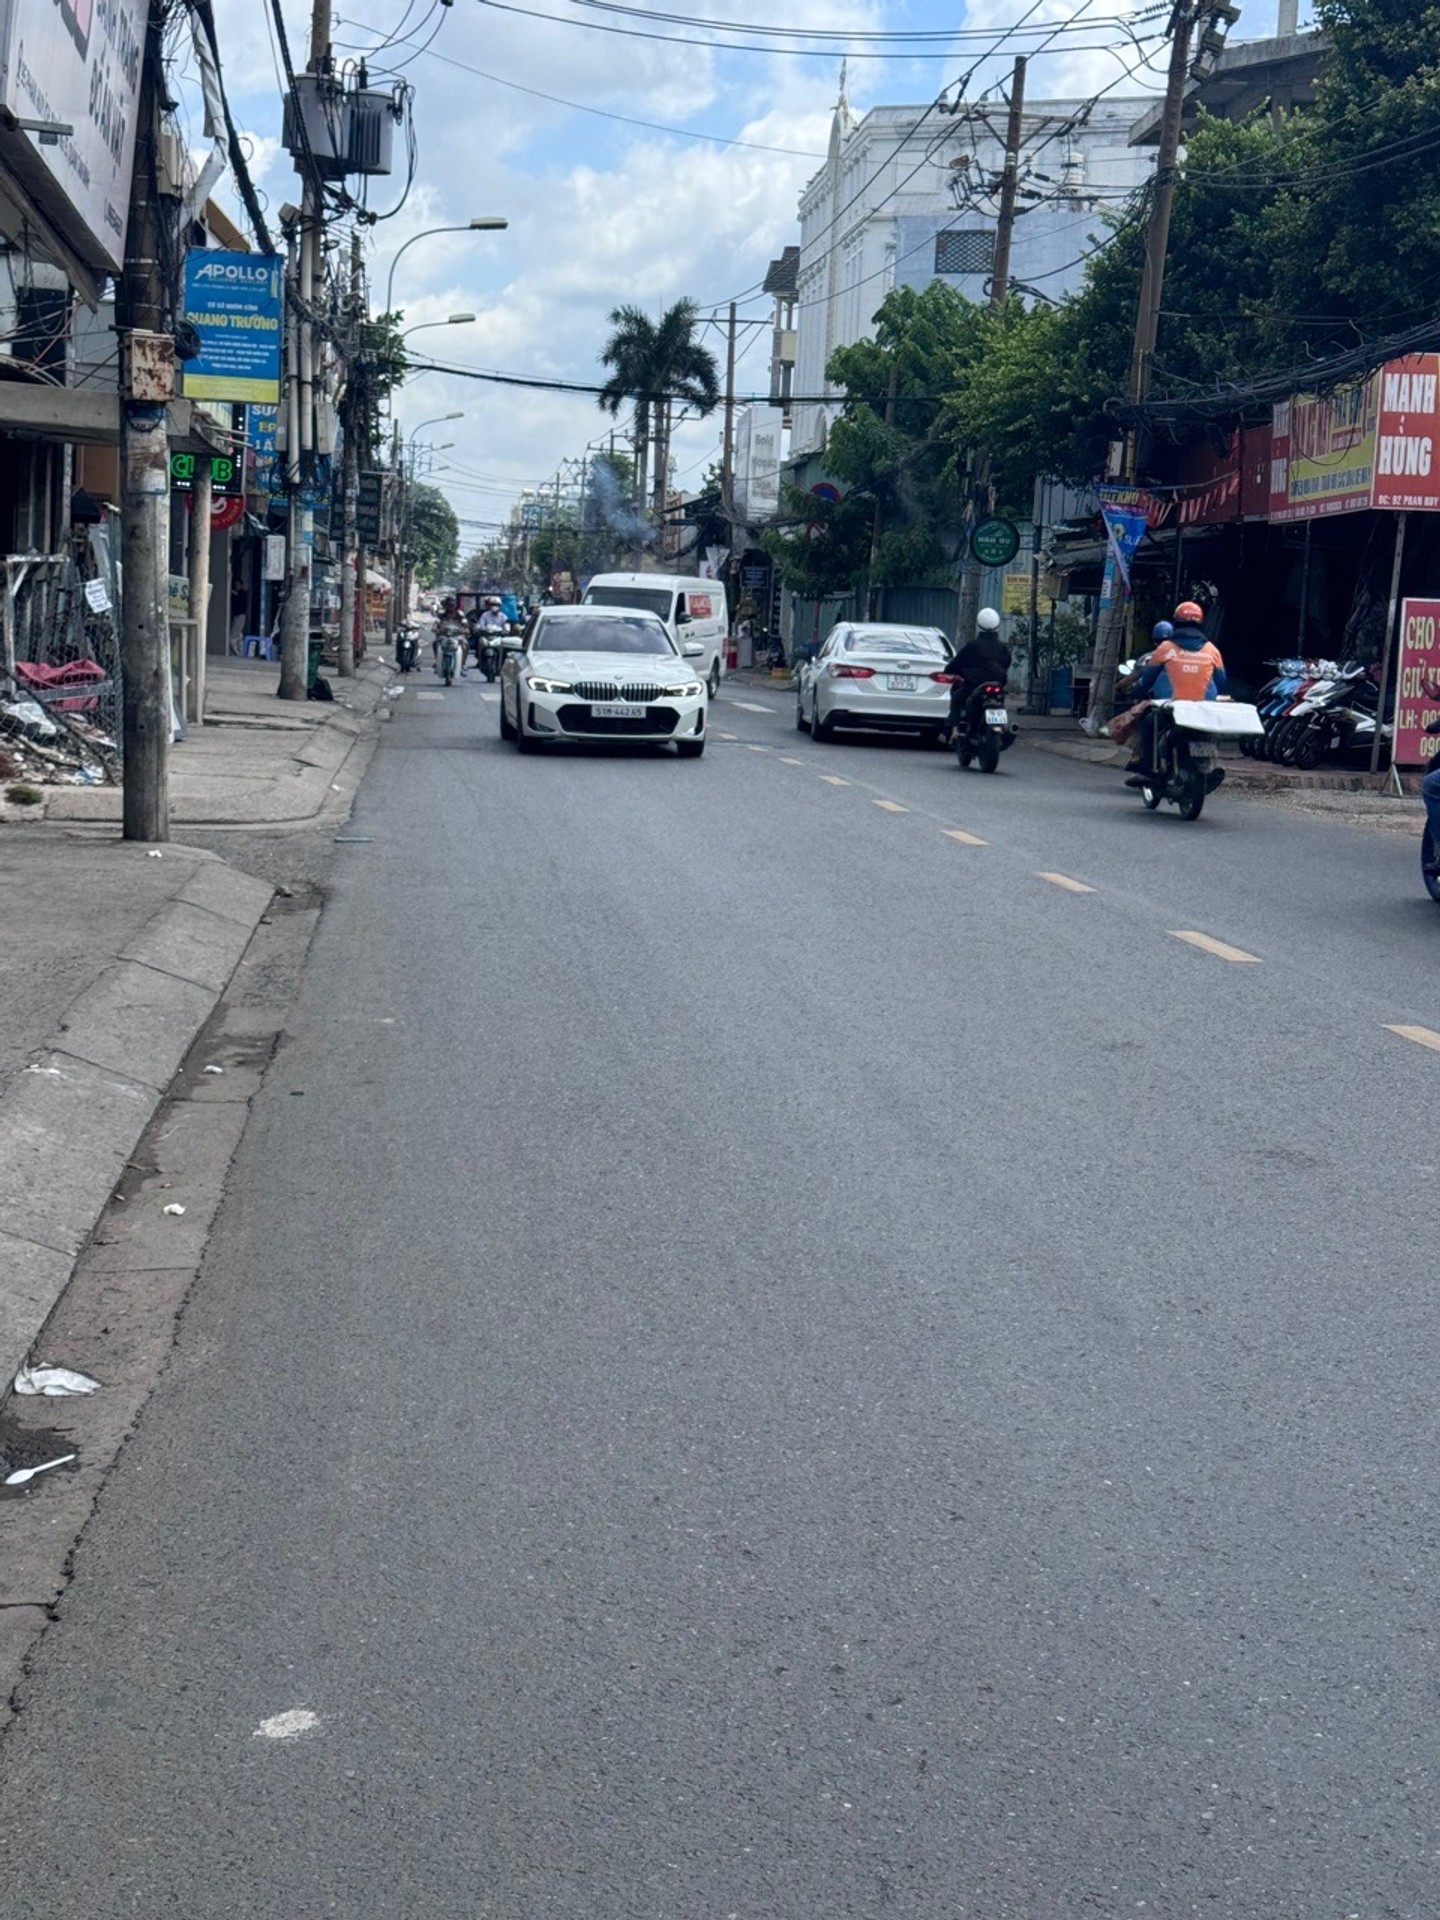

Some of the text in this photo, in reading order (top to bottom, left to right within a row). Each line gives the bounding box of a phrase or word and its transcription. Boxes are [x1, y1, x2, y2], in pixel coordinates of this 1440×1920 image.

[194, 263, 268, 280] APOLLO
[230, 313, 278, 330] TRƯỜNG
[1406, 616, 1435, 650] CHO
[1399, 708, 1440, 731] LH: 09
